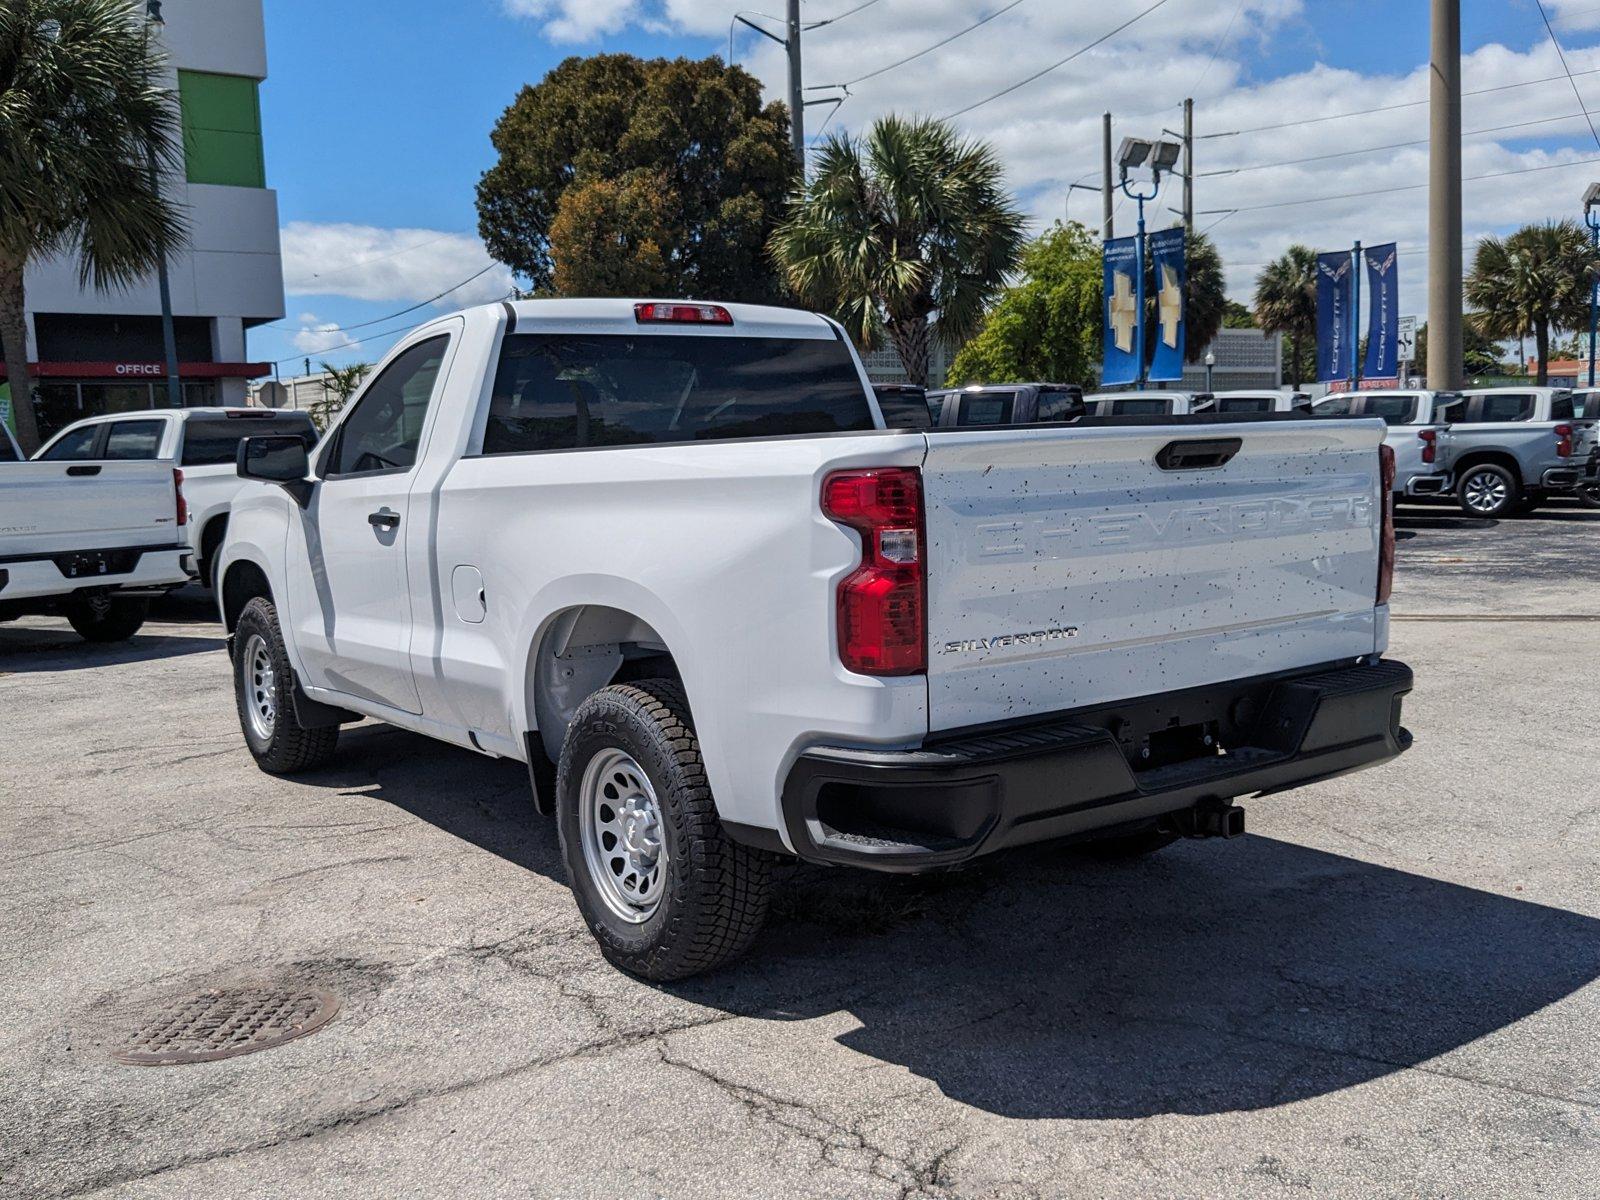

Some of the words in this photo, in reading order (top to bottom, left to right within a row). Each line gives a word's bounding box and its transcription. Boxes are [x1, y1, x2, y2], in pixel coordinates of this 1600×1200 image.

[1331, 287, 1340, 374] CORVETTE
[1377, 282, 1386, 371] CORVETTE
[115, 364, 161, 375] OFFICE
[975, 497, 1370, 557] CHEVROLET
[944, 626, 1078, 653] SILVERADO
